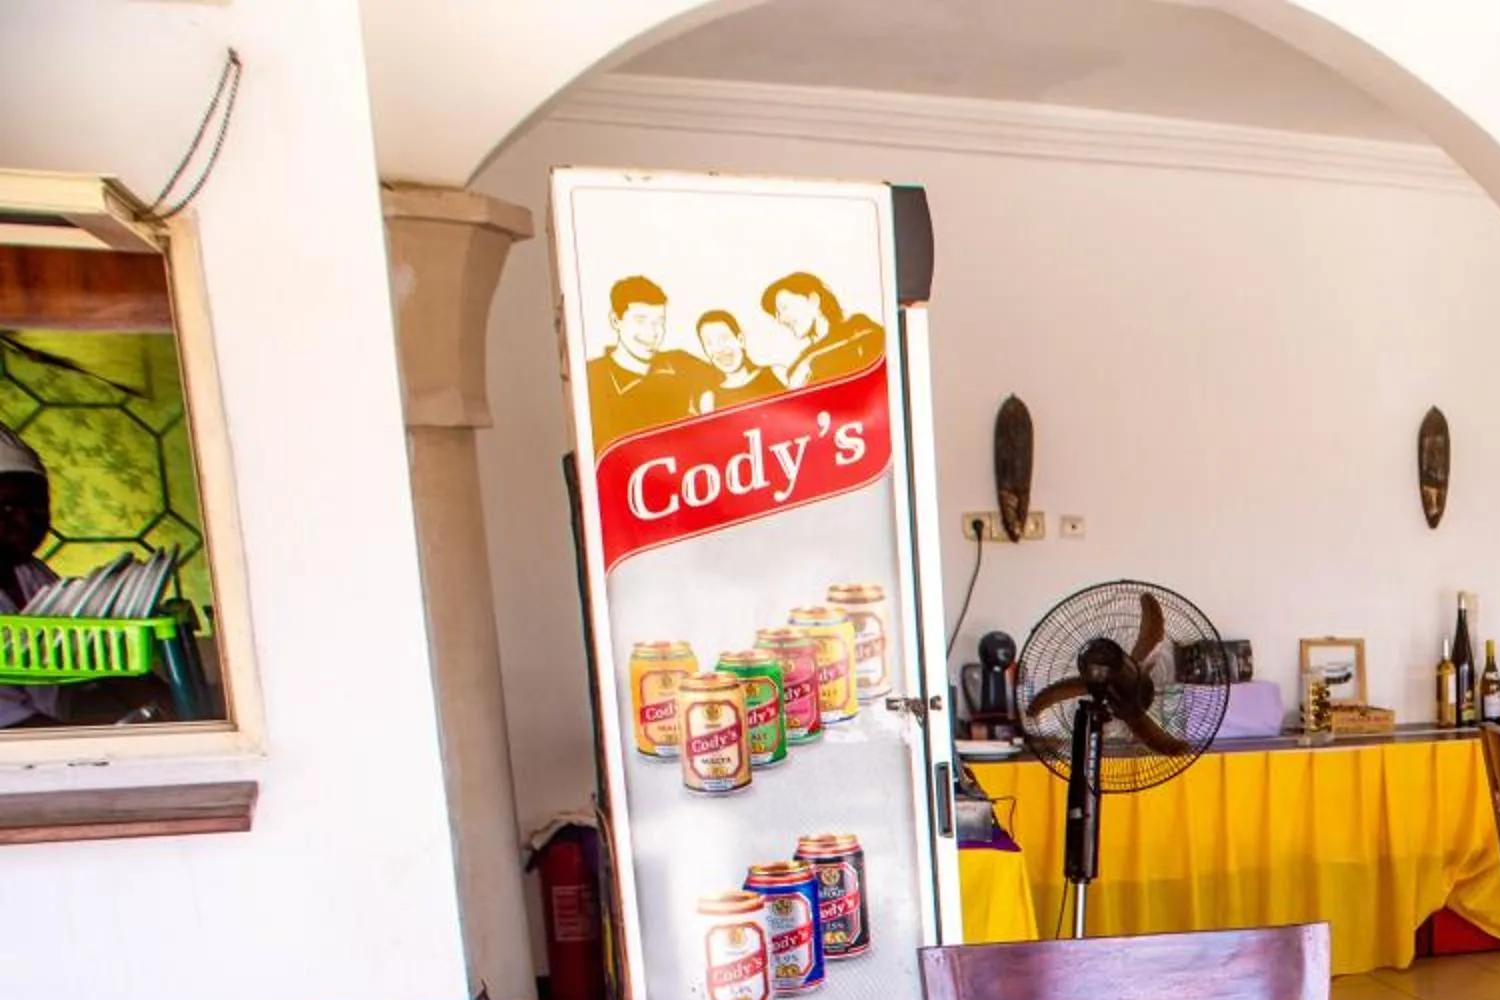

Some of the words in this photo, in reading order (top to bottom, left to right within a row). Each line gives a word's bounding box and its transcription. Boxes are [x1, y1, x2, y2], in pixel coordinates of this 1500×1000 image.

[626, 411, 867, 521] Cody's
[690, 730, 739, 753] Cody's
[820, 896, 856, 920] ody's
[772, 929, 810, 952] ody's
